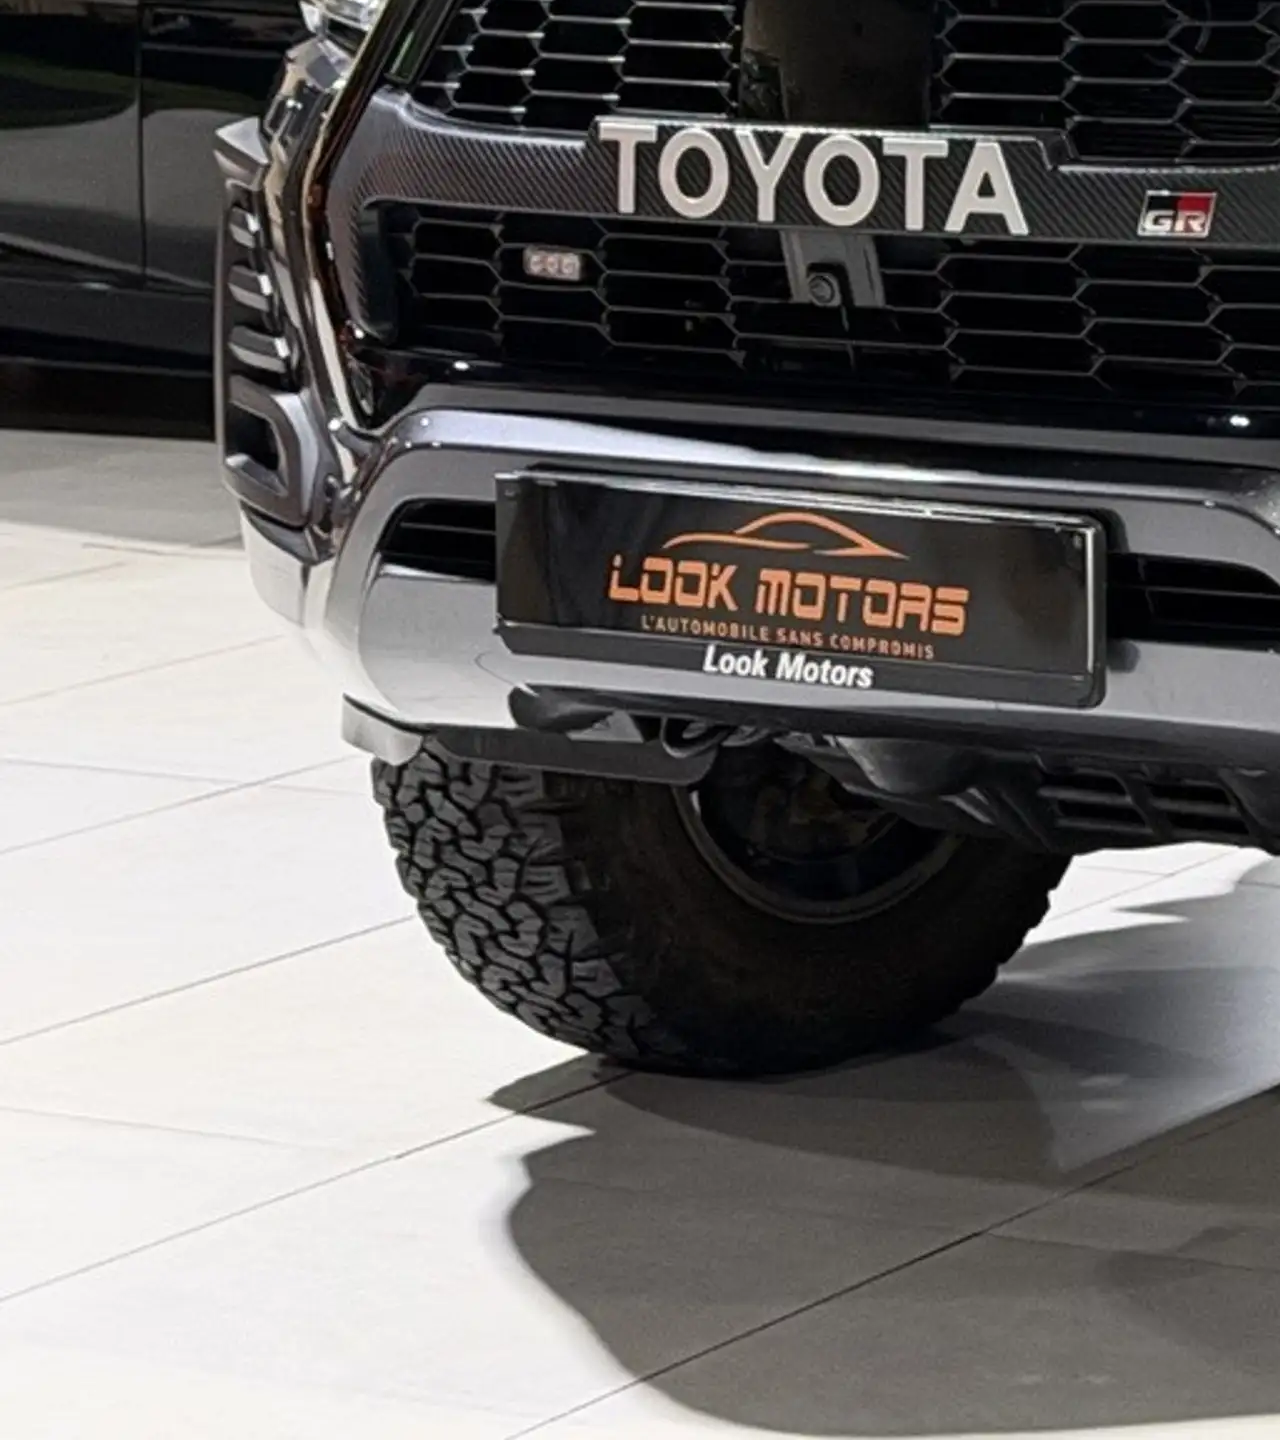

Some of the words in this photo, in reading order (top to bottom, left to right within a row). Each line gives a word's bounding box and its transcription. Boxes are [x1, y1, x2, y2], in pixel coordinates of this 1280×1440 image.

[599, 123, 1029, 236] TOYOTA
[1144, 210, 1207, 233] GR
[608, 554, 738, 611] LOOK
[755, 567, 970, 637] MOTORS
[641, 614, 771, 643] L'AUTOMOBILE
[776, 628, 823, 648] SANS
[829, 634, 935, 660] COMPROMIS
[703, 644, 770, 678] Look
[776, 653, 875, 689] Motors
